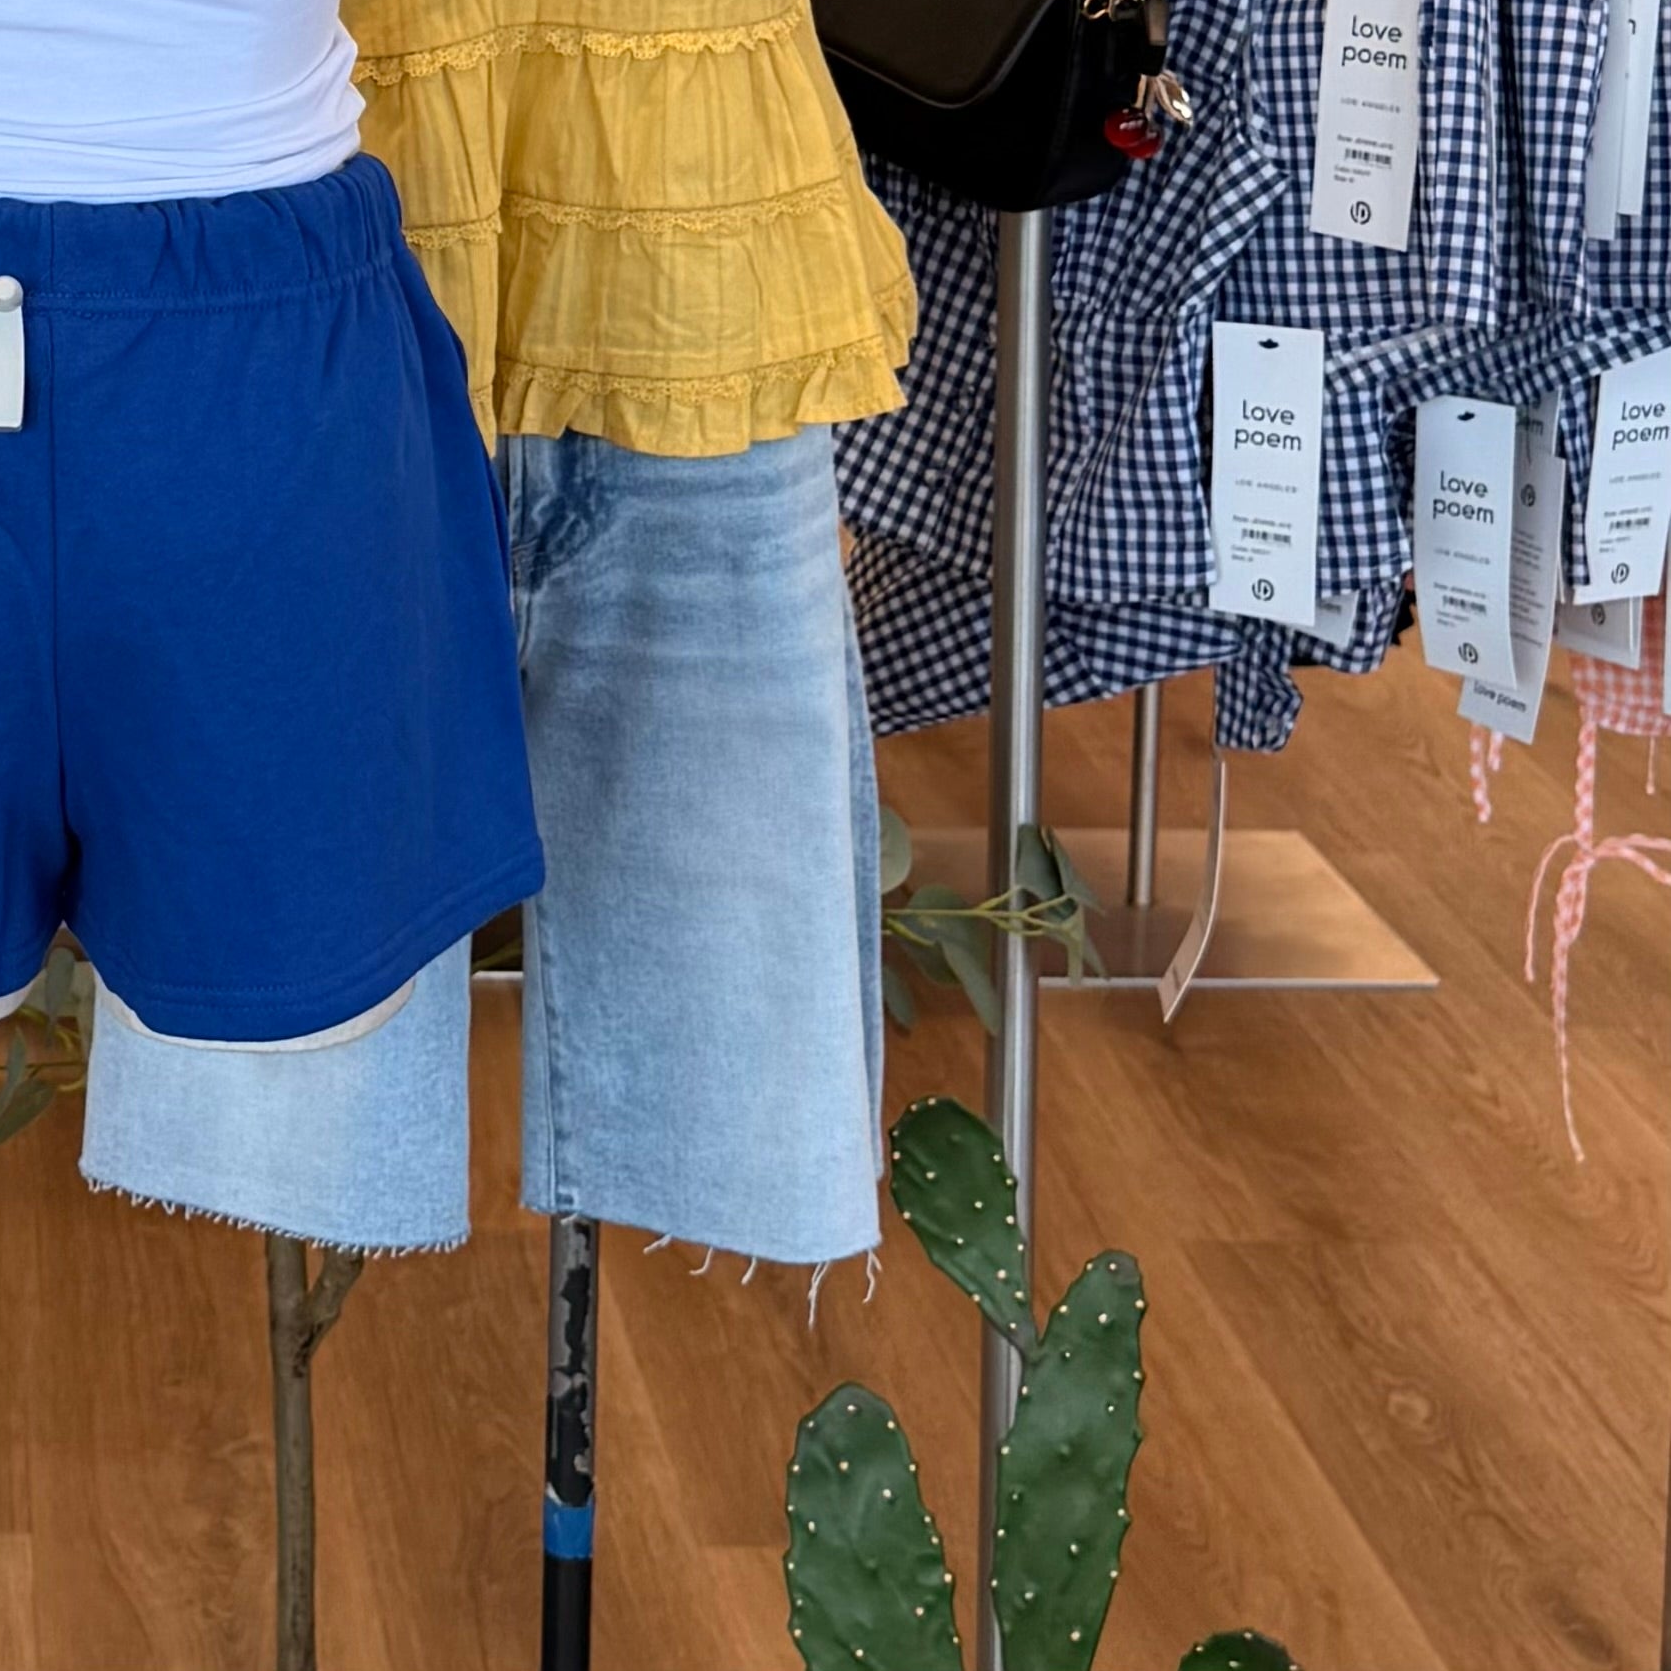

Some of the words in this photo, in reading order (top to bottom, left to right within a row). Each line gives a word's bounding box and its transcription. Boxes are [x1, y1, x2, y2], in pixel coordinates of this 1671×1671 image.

[1341, 46, 1407, 70] poem
[1234, 428, 1302, 451] poem
[1612, 425, 1670, 451] poem
[1432, 498, 1494, 525] poem
